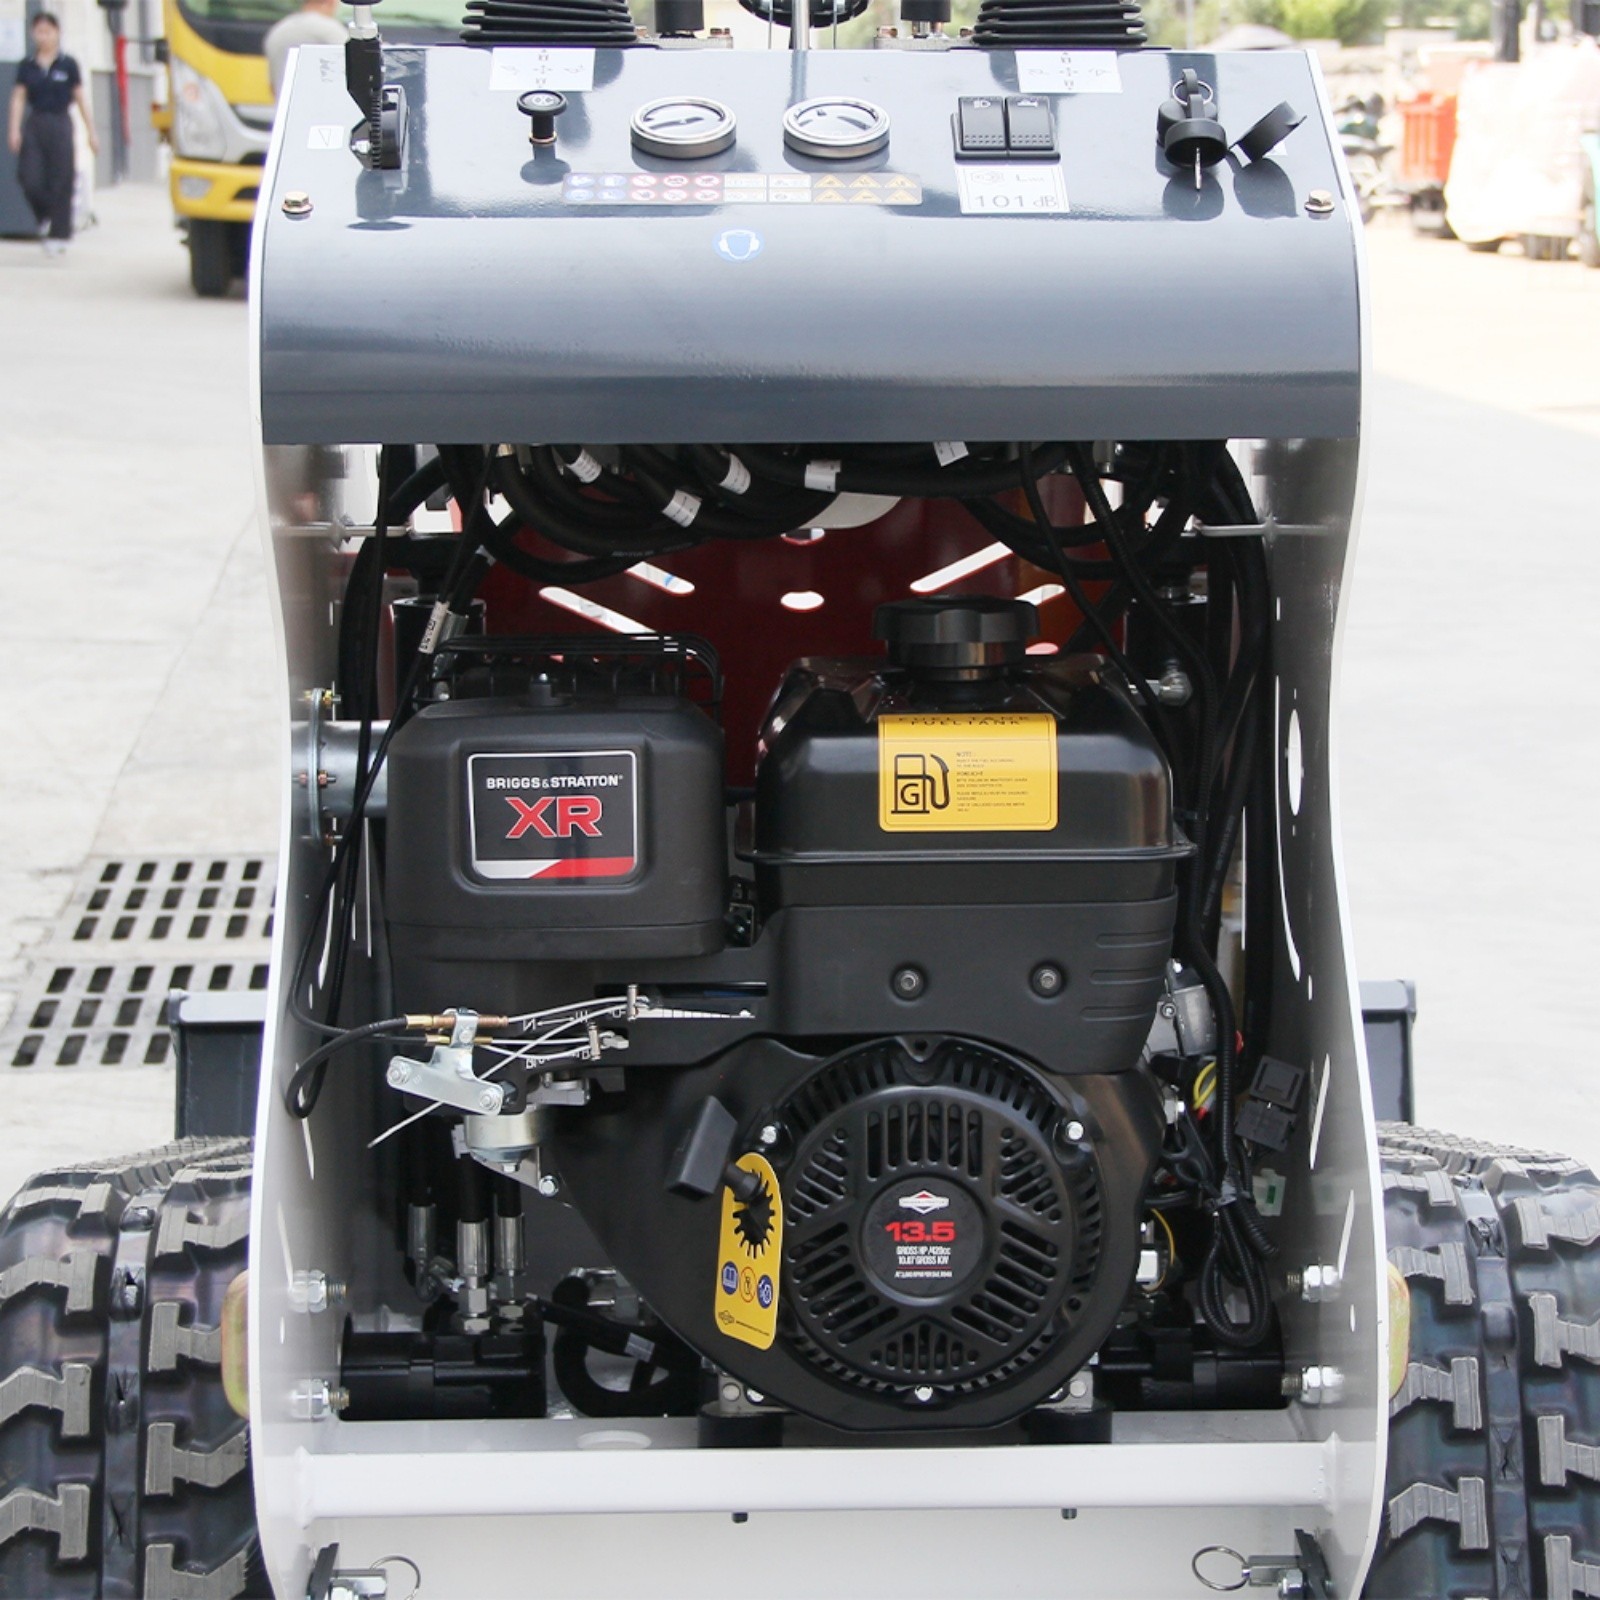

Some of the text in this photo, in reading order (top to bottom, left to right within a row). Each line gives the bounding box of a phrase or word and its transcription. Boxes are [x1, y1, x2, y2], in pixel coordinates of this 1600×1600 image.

[974, 194, 1058, 209] 101 dB
[505, 795, 603, 839] XR
[885, 1221, 956, 1243] 13.5
